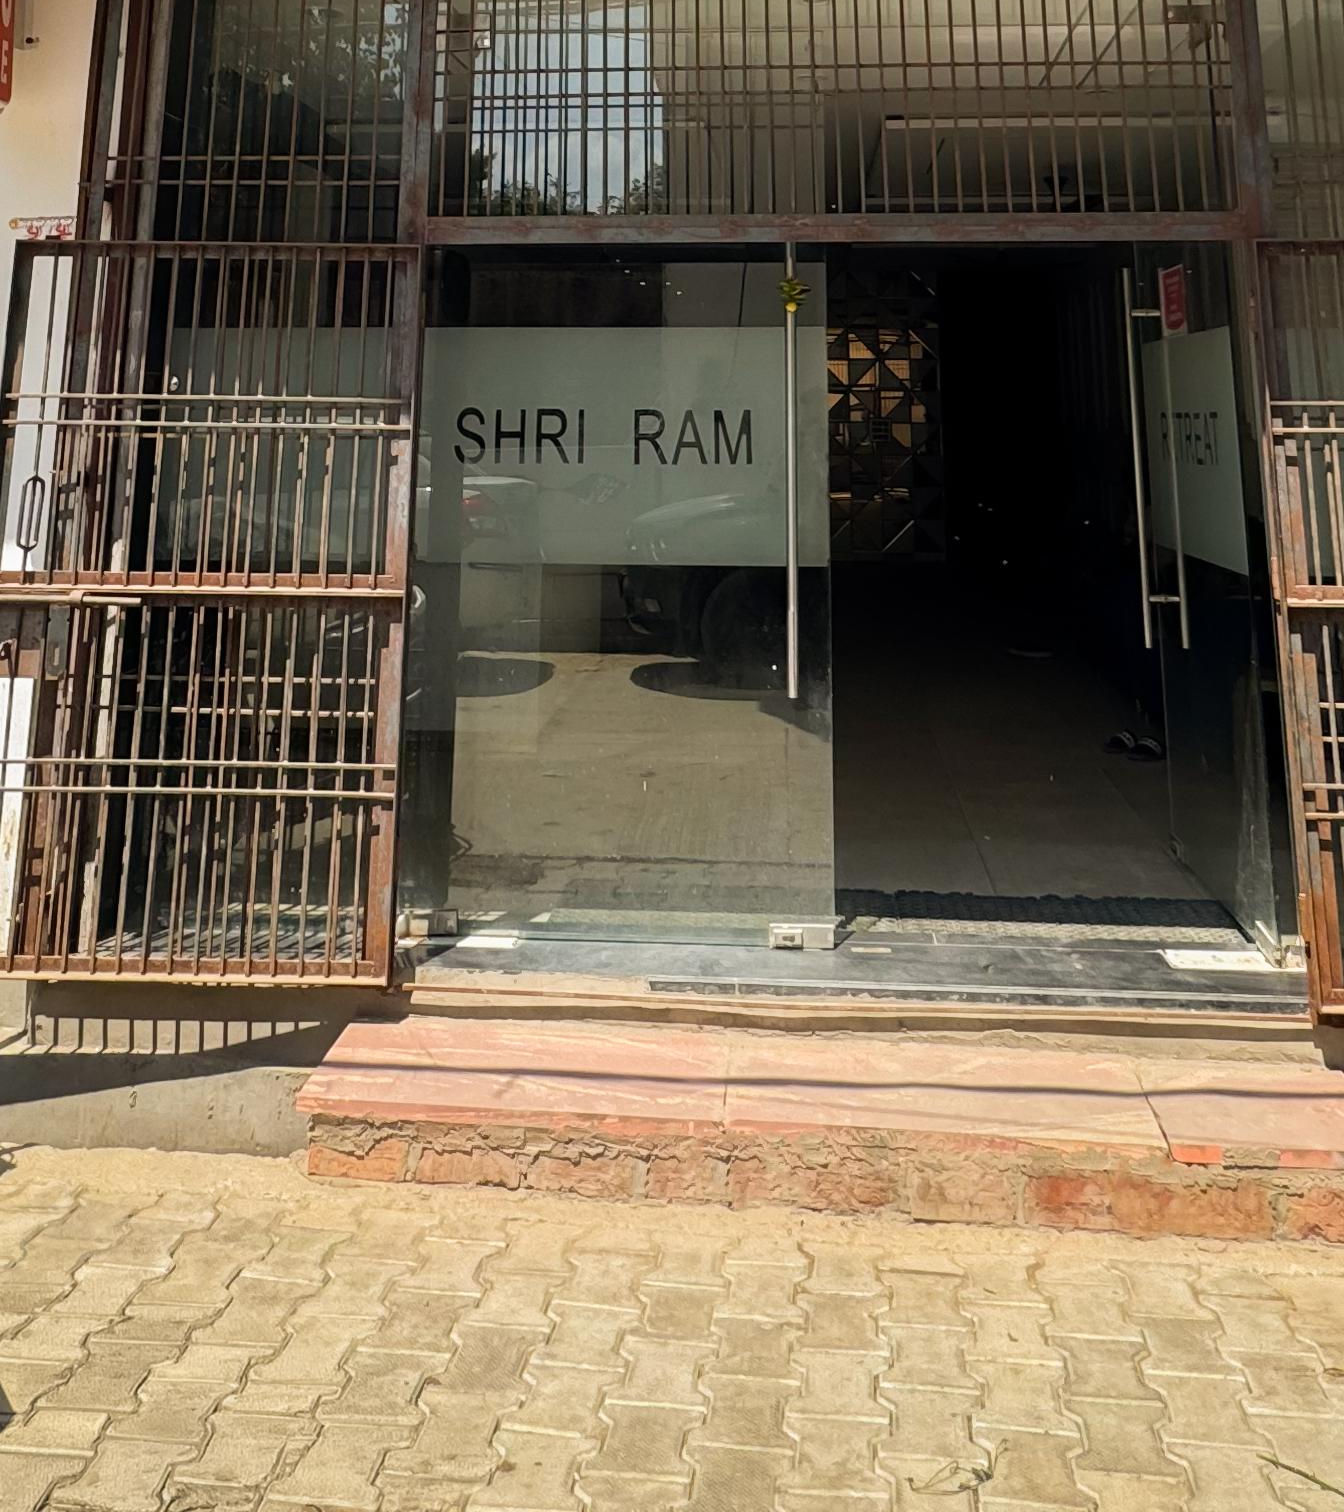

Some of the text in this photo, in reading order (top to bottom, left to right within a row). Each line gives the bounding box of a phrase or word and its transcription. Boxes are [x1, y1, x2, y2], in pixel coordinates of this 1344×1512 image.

[454, 407, 753, 466] SHRI RAM
[1159, 411, 1219, 466] RTREAT
